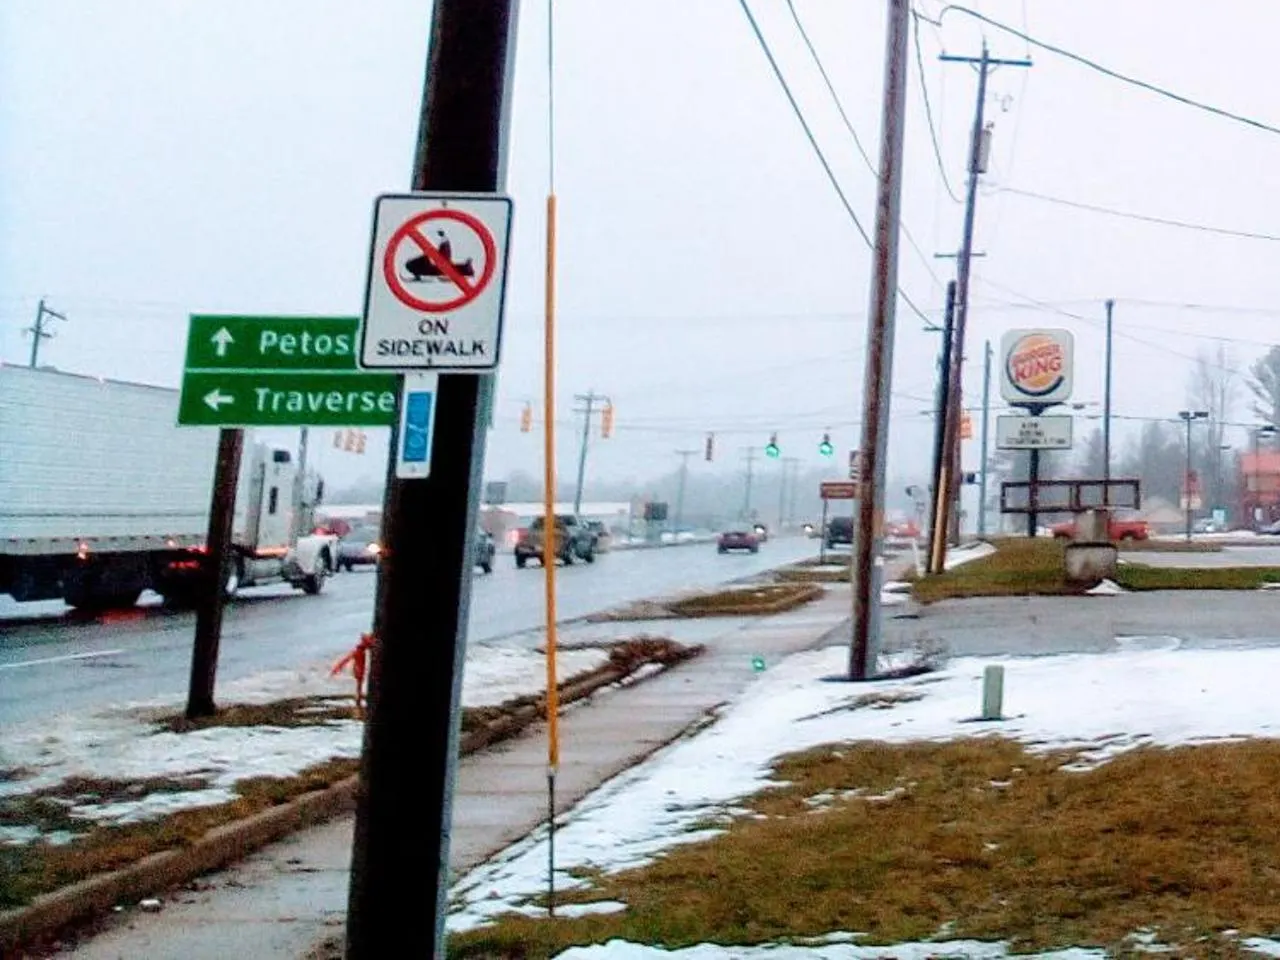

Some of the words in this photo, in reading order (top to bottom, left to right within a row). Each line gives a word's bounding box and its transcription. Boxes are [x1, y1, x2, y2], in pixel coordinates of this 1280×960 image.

[418, 319, 449, 335] ON
[259, 330, 358, 355] Petos
[377, 339, 485, 356] SIDEWALK
[1013, 355, 1063, 382] KING
[254, 387, 396, 412] Traverse
